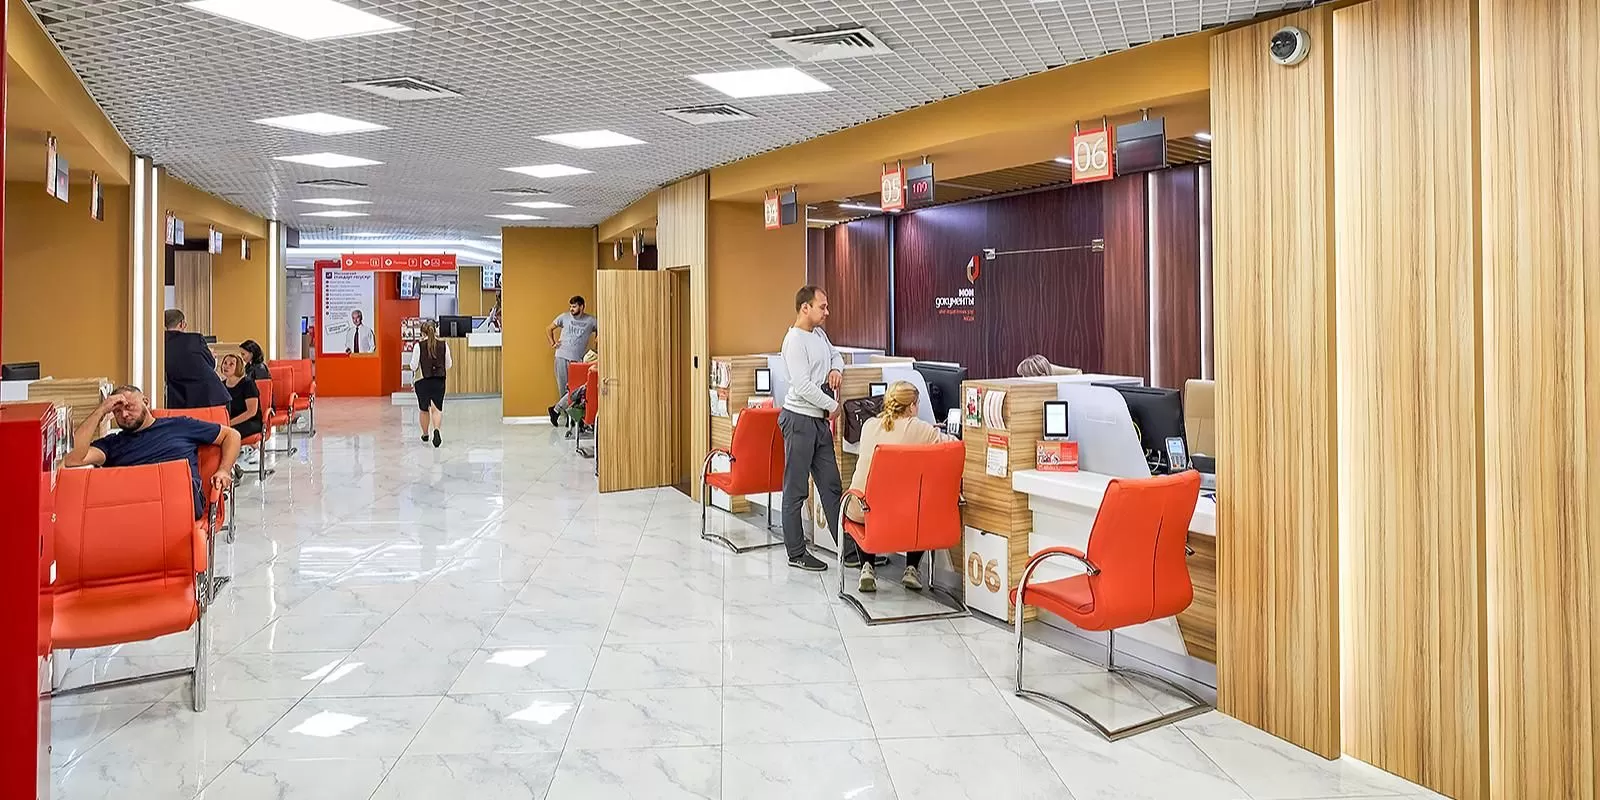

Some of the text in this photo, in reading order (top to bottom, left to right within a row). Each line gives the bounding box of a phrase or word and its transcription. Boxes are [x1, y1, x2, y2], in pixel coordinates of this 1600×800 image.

[1075, 137, 1107, 172] 06
[882, 178, 900, 203] 05
[764, 203, 778, 224] 04
[967, 551, 1001, 593] 06
